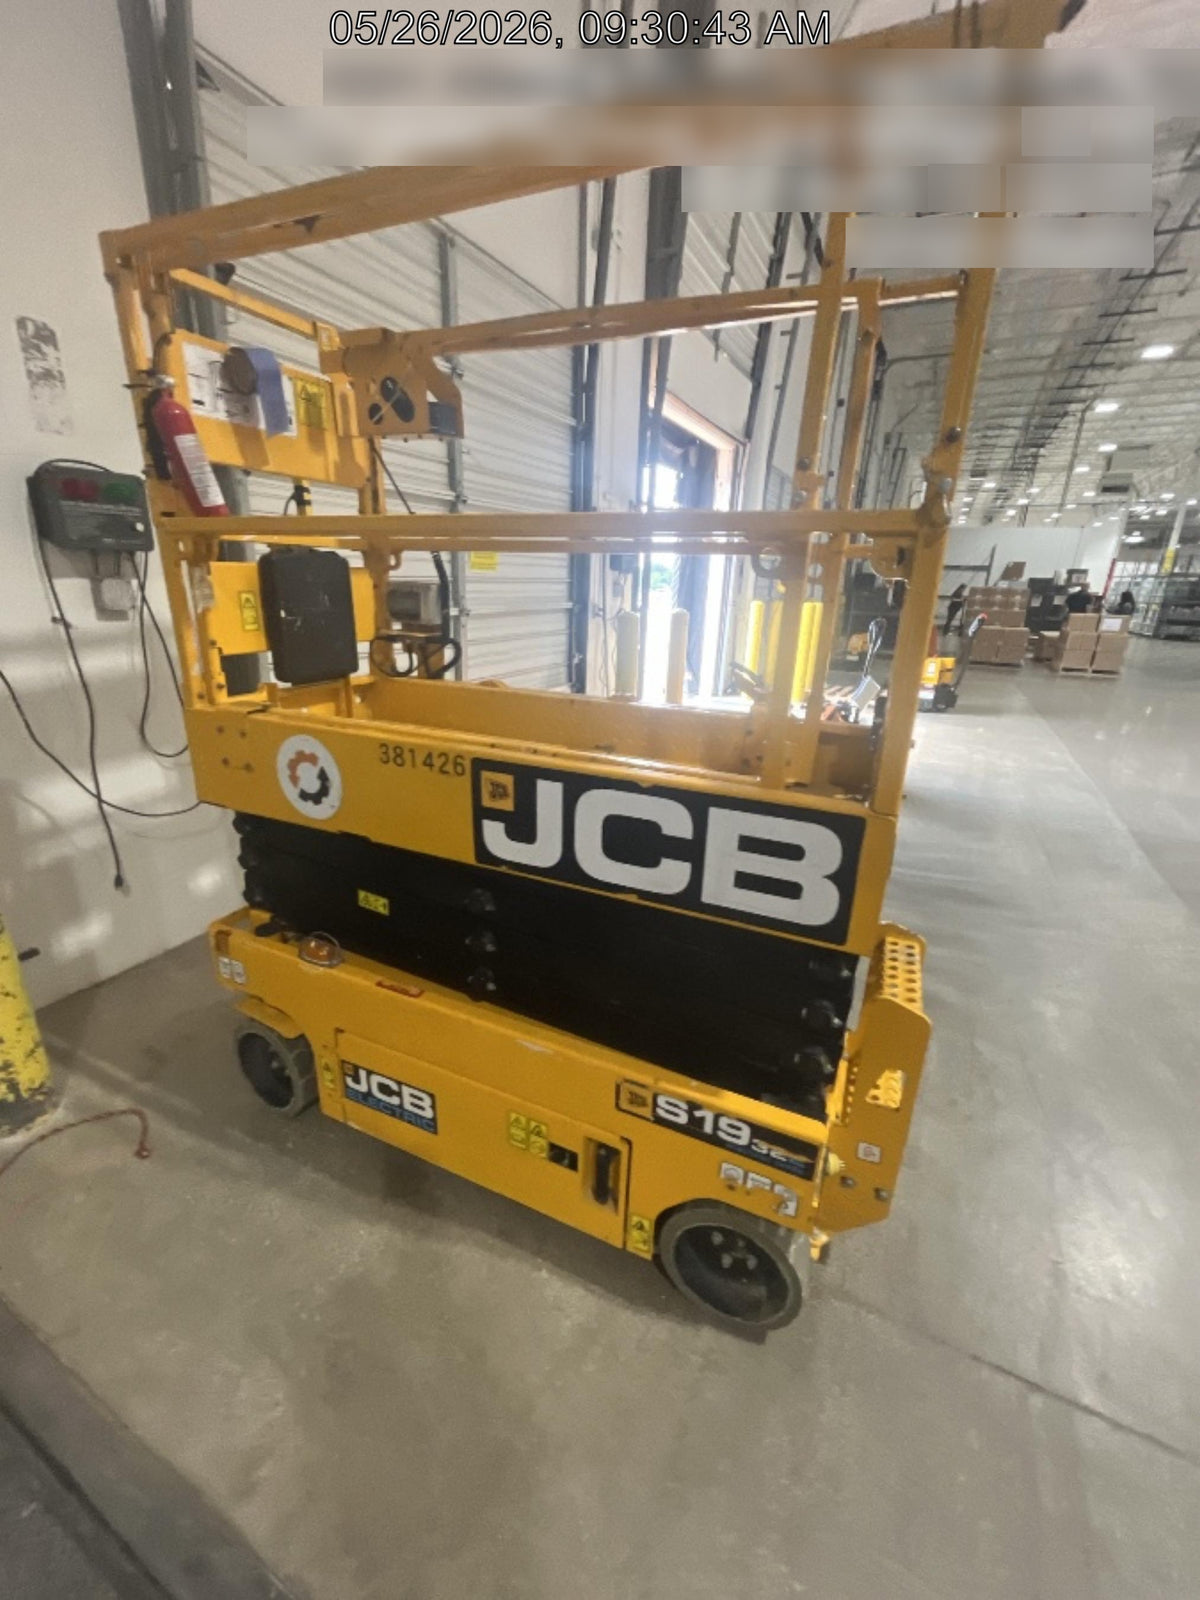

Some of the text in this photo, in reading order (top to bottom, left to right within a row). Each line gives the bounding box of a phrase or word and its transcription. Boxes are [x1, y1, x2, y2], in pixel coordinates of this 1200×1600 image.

[379, 743, 467, 777] 381426
[482, 778, 844, 926] JCB
[344, 1067, 435, 1119] JCB
